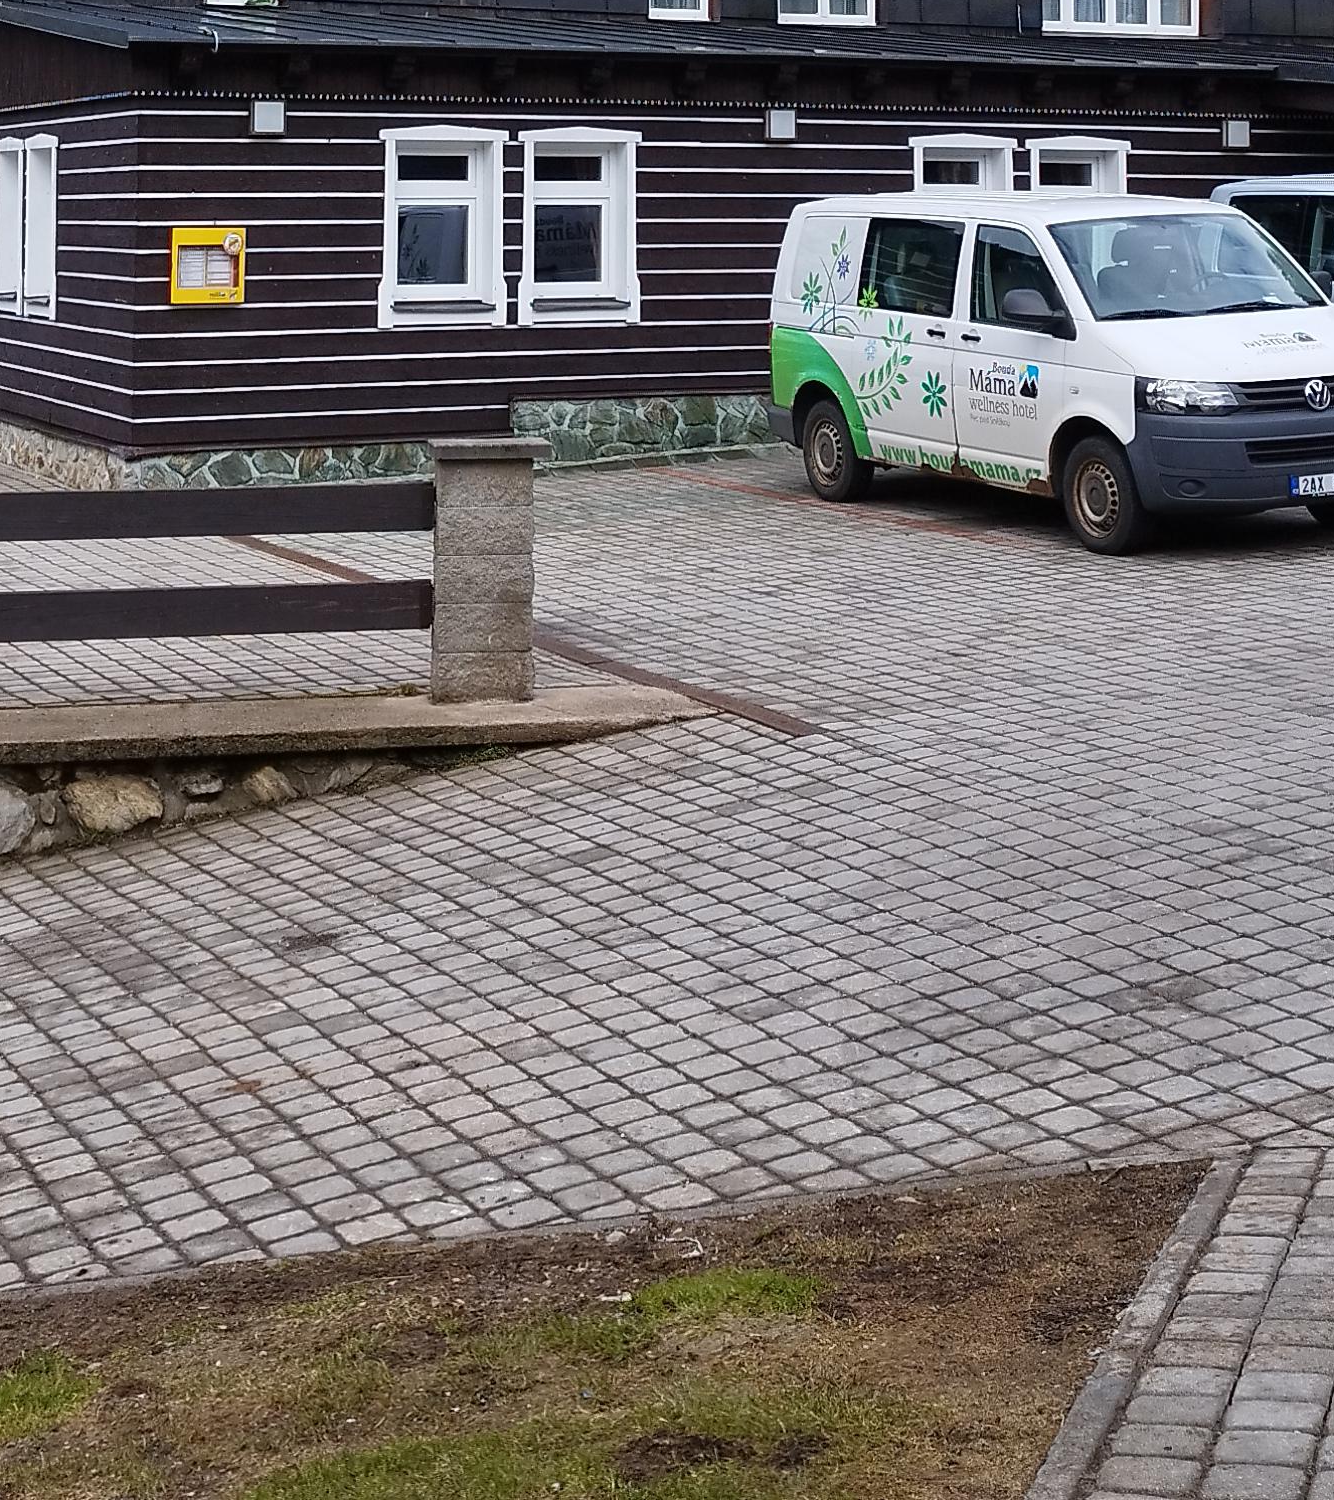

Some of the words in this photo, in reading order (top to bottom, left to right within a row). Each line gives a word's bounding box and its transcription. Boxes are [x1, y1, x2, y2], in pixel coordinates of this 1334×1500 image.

[969, 367, 1016, 397] Máma
[968, 396, 1010, 415] wellness
[1012, 400, 1038, 421] hotel
[1302, 476, 1324, 493] 2AX
